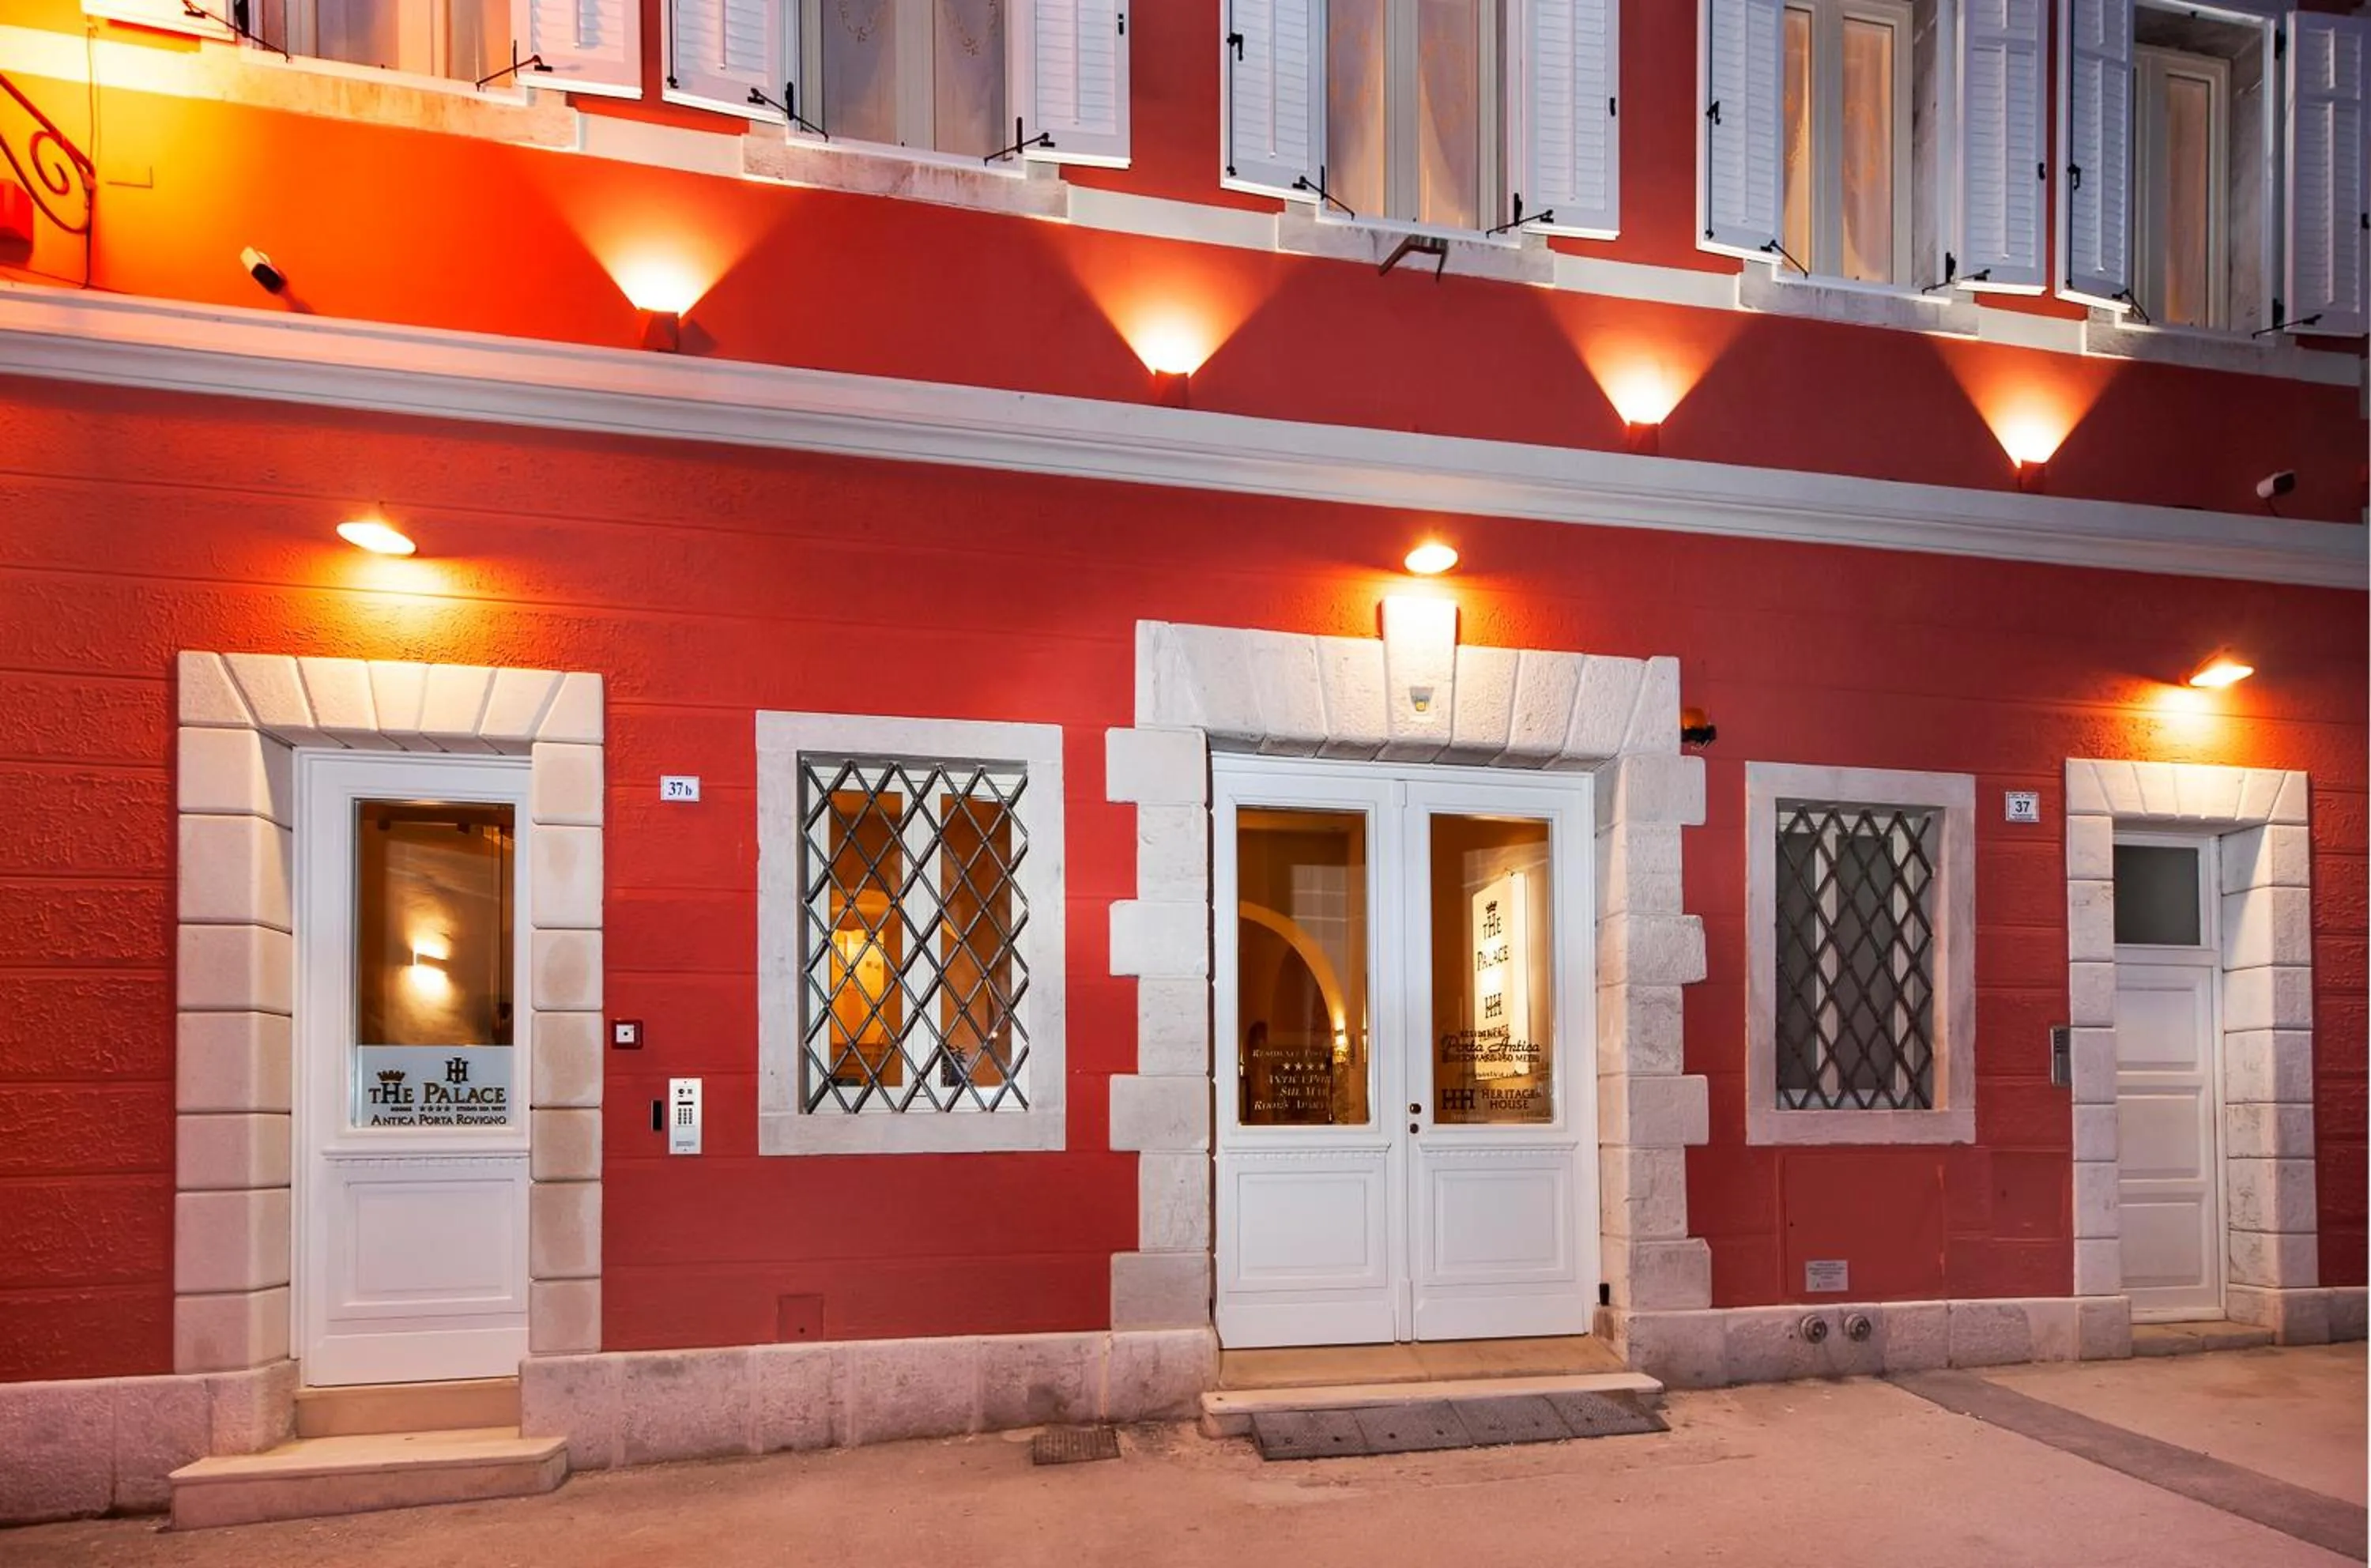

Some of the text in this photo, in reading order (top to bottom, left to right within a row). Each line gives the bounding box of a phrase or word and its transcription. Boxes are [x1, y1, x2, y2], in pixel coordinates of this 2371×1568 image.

[2015, 801, 2030, 813] 37
[1483, 913, 1502, 940] THE
[1476, 945, 1509, 971] PALACE
[368, 1082, 507, 1104] THE PALACE
[1482, 1088, 1536, 1099] HERITAGE
[1490, 1099, 1530, 1110] HOUSE
[371, 1114, 507, 1126] ANTICA PORTA ROVIGNO
